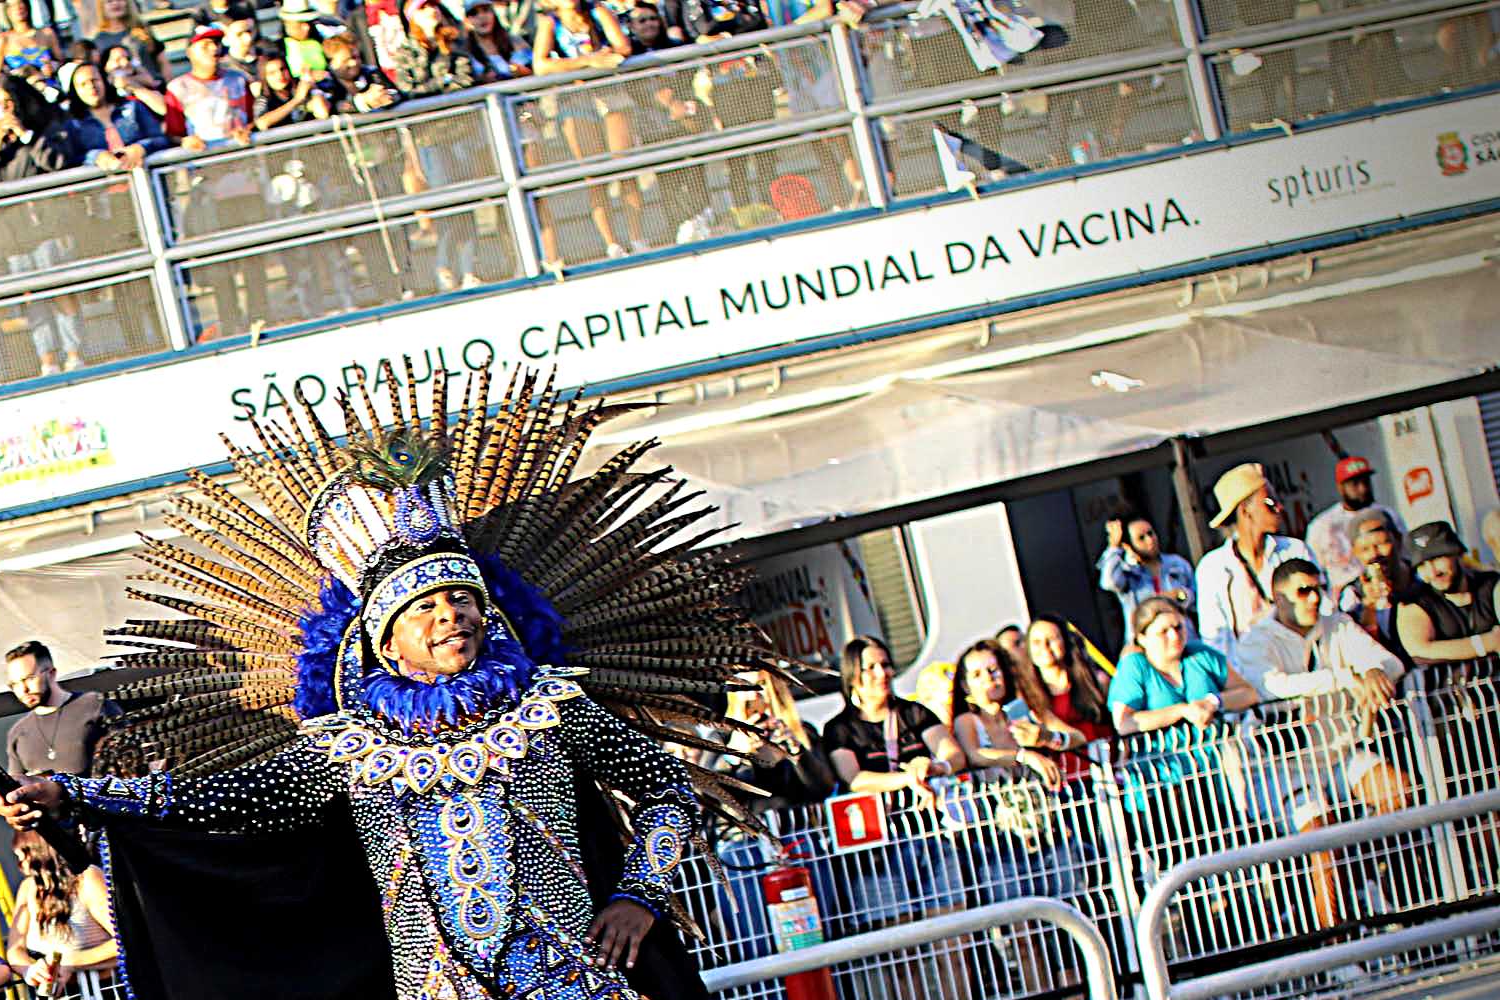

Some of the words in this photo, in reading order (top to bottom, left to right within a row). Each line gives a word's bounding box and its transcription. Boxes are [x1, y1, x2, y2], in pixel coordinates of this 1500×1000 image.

[1267, 156, 1371, 207] spturis
[230, 371, 328, 421] SÃO
[341, 338, 509, 397] PAULO,
[520, 294, 709, 359] CAPITAL
[719, 249, 934, 320] MUNDIAL
[944, 235, 1011, 274] DA
[1017, 197, 1201, 258] VACINA.
